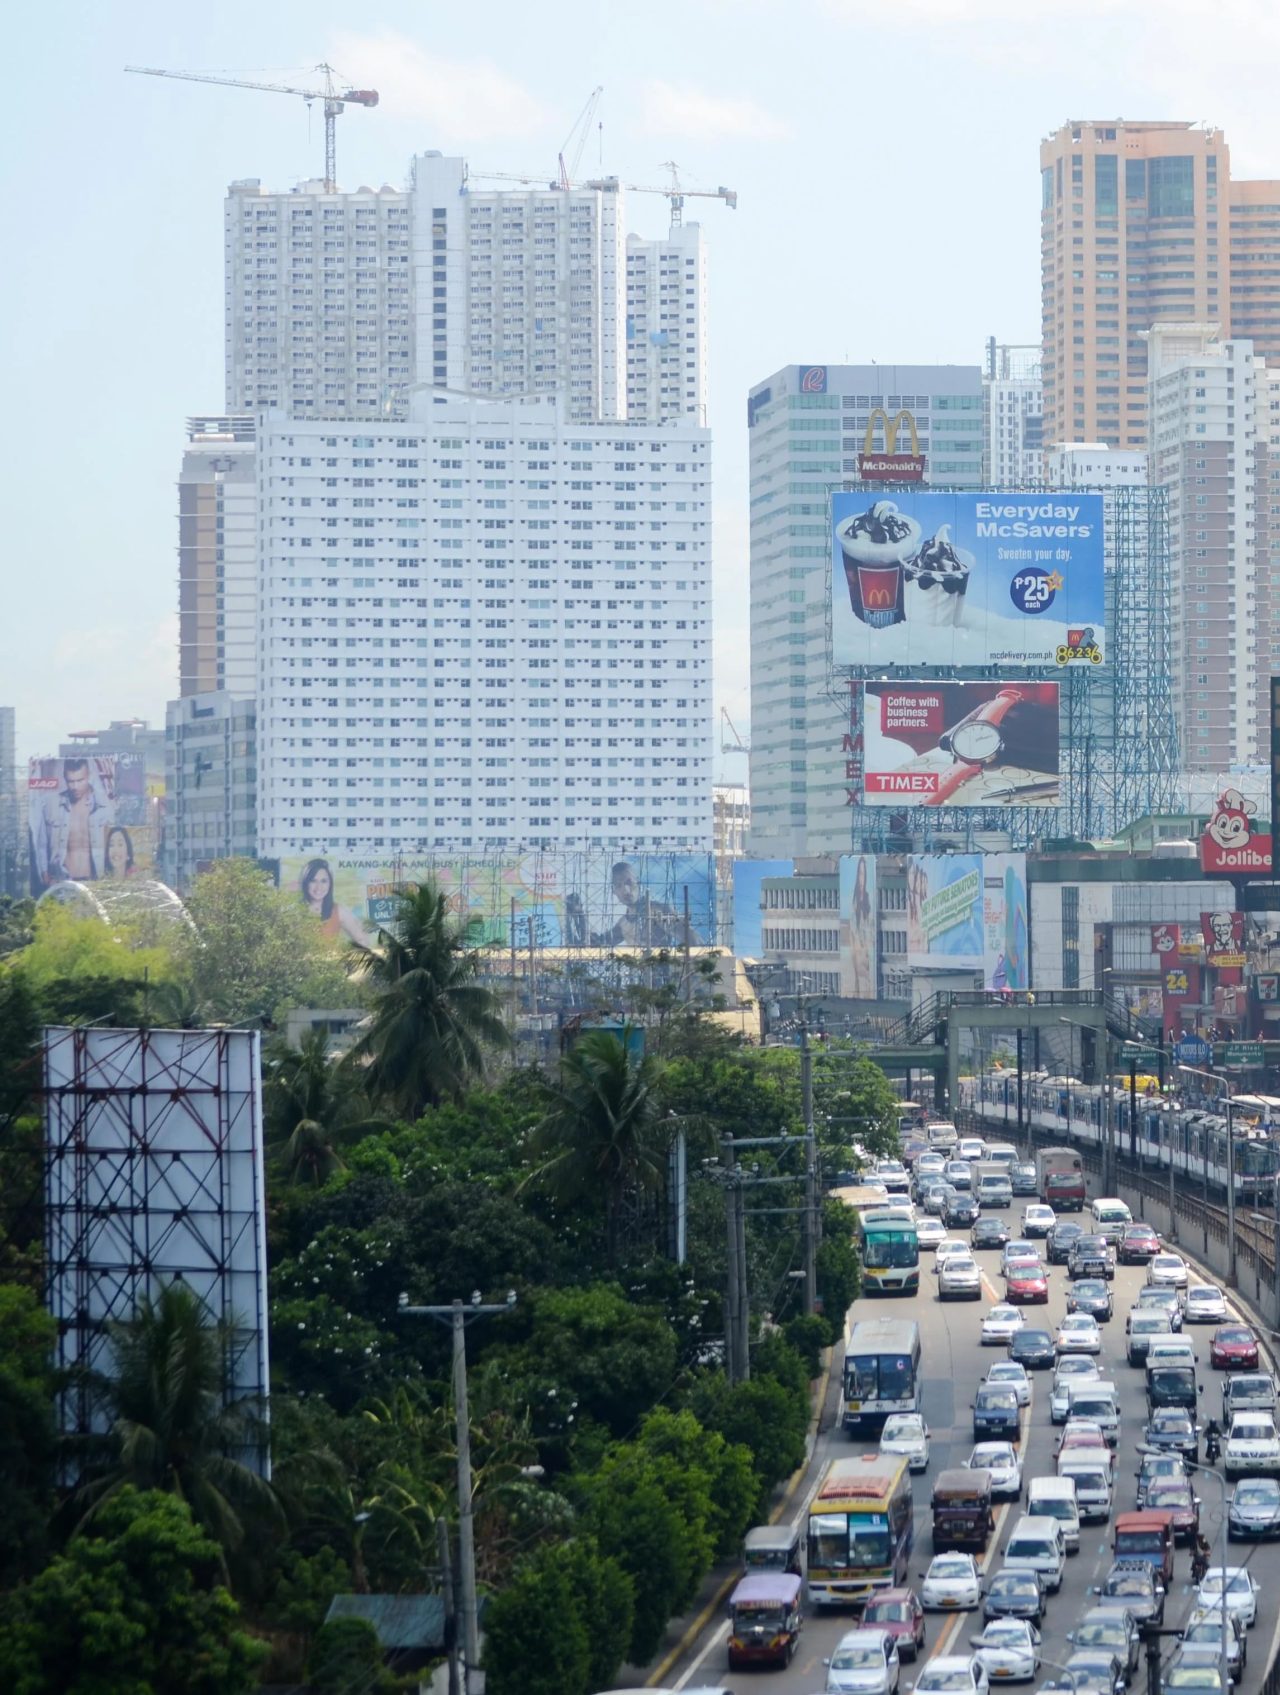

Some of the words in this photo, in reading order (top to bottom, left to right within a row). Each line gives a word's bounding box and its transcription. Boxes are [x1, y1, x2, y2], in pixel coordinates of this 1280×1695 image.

[862, 460, 922, 472] McDonald's
[976, 502, 1080, 521] Everyday
[998, 548, 1032, 560] Sweeten
[1035, 549, 1053, 562] your
[1056, 548, 1072, 562] day.
[990, 651, 1052, 661] mcdelivery.com.ph
[887, 696, 916, 707] Coffee
[919, 696, 939, 707] with
[887, 707, 928, 717] business
[887, 718, 928, 728] partners.
[841, 681, 864, 806] TIMEX
[876, 776, 935, 790] TIMEX
[1166, 974, 1188, 990] 24
